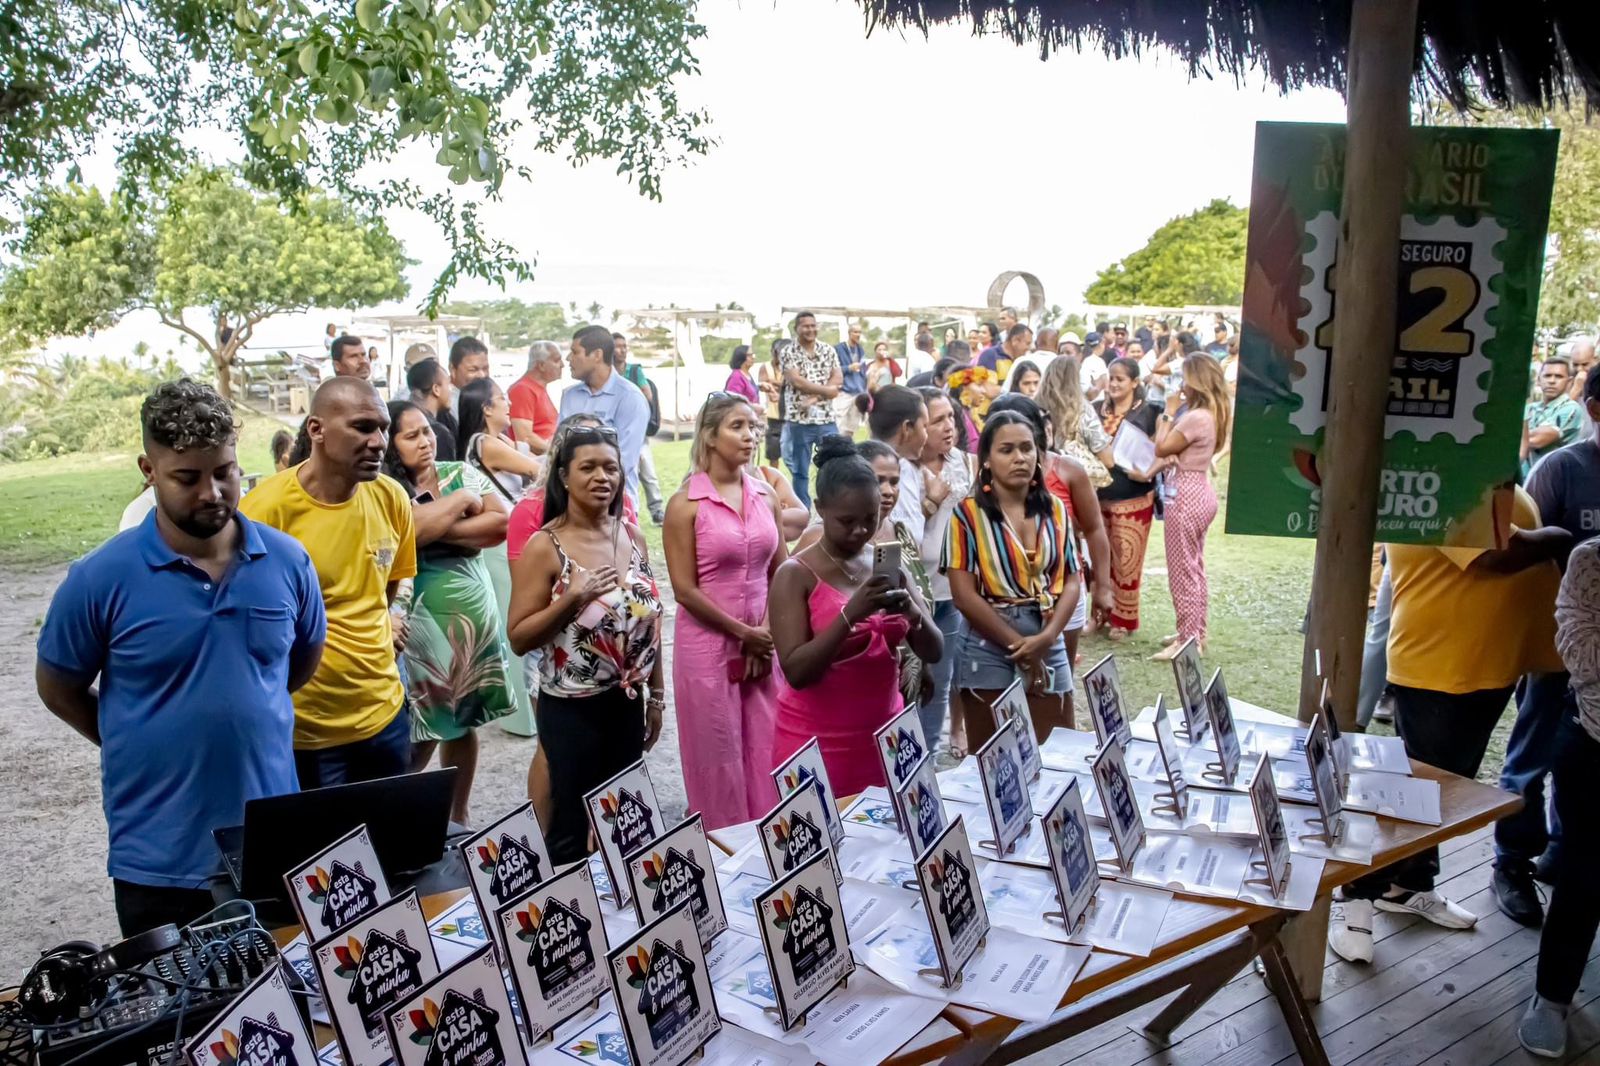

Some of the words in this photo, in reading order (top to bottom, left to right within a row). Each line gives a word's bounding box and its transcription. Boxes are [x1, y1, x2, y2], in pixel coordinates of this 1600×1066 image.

[1401, 244, 1466, 264] SEGURO
[1394, 356, 1408, 369] E
[1389, 376, 1450, 402] RIL
[1380, 469, 1441, 496] RTO
[897, 742, 916, 765] CASA
[616, 804, 643, 831] CASA
[620, 799, 633, 813] esta
[919, 797, 934, 825] CASA
[628, 819, 648, 841] minha
[788, 826, 813, 857] CASA
[792, 823, 803, 836] esta
[497, 850, 529, 881] CASA
[502, 847, 517, 861] esta
[660, 865, 694, 897] CASA
[667, 860, 682, 876] esta
[328, 877, 364, 911] CASA
[333, 874, 350, 890] esta
[502, 880, 508, 897] é
[510, 867, 534, 893] minha
[672, 882, 698, 906] minha
[943, 866, 964, 898] CASA
[334, 909, 342, 927] é
[343, 893, 369, 922] minha
[546, 911, 564, 928] esta
[791, 903, 822, 938] CASA
[796, 899, 811, 916] esta
[538, 915, 578, 950] CASA
[802, 922, 826, 950] minha
[368, 945, 389, 962] esta
[542, 950, 549, 968] é
[552, 934, 582, 963] minha
[653, 955, 670, 972] esta
[360, 948, 405, 986] CASA
[647, 958, 683, 996] CASA
[816, 964, 831, 982] ALVES
[829, 953, 845, 973] RAMOS
[365, 986, 373, 1005] é
[376, 967, 411, 999] minha
[651, 995, 658, 1015] é
[660, 979, 687, 1009] minha
[445, 1005, 466, 1026] esta
[244, 1032, 264, 1055] esta
[437, 1009, 483, 1053] CASA
[454, 1031, 489, 1066] minha
